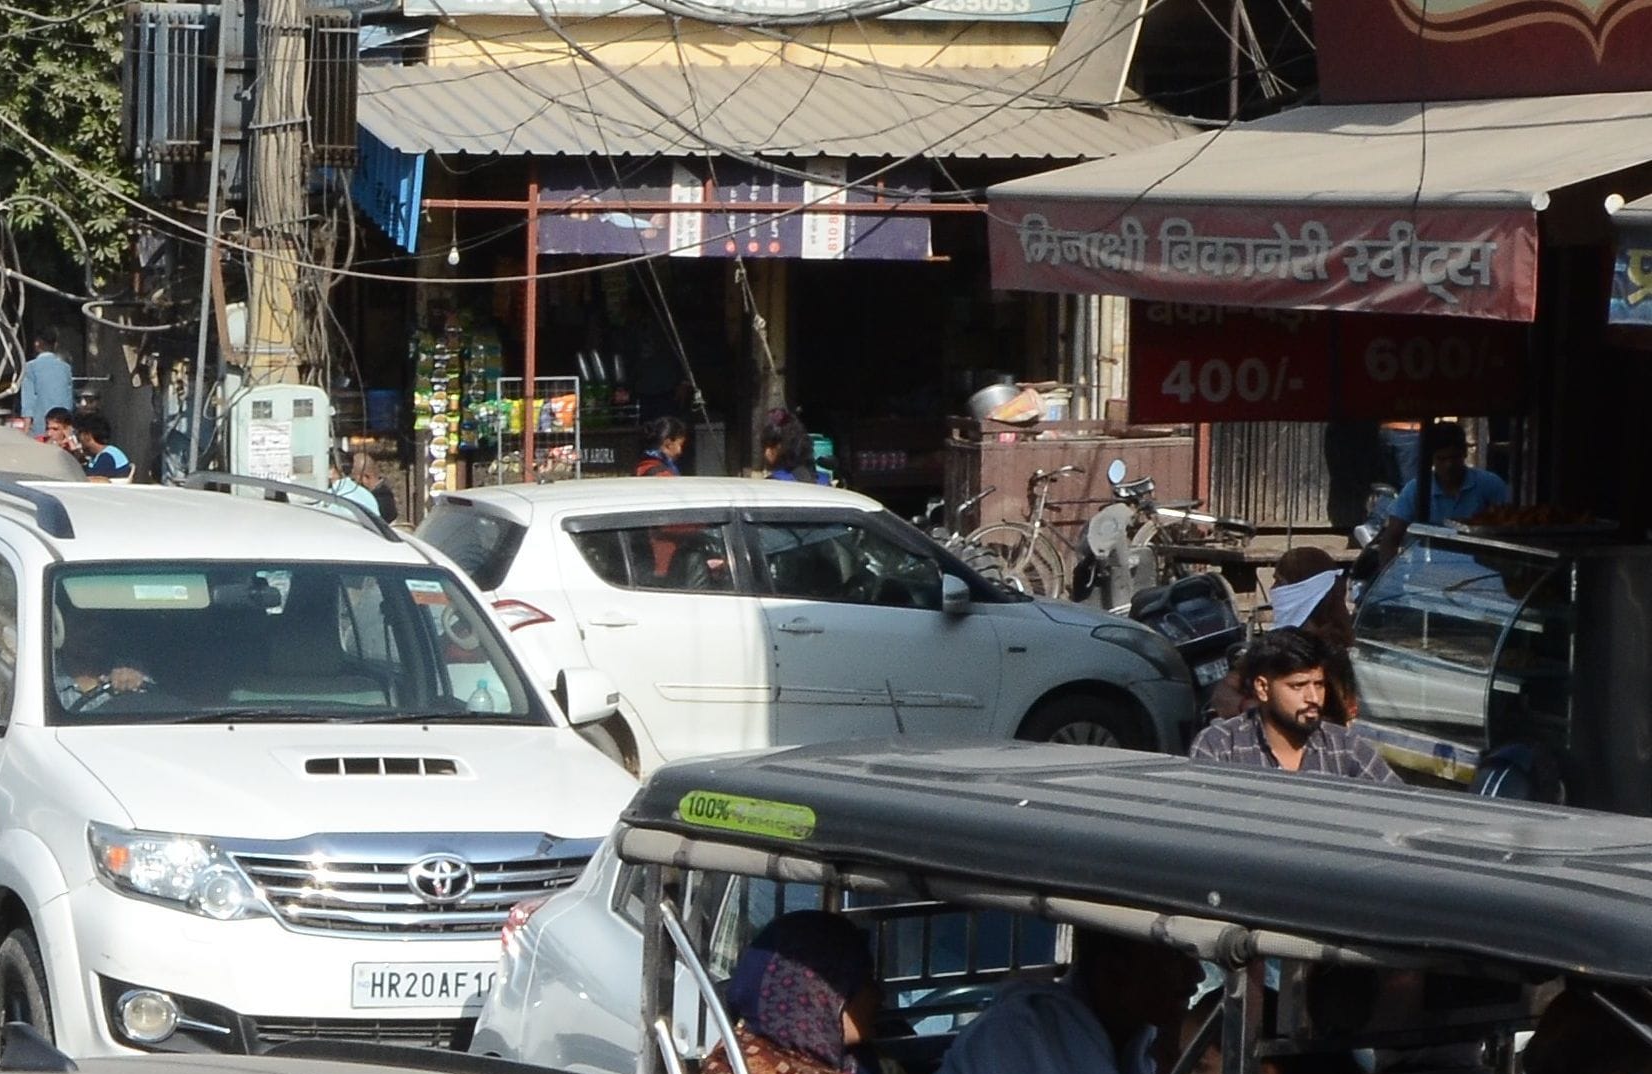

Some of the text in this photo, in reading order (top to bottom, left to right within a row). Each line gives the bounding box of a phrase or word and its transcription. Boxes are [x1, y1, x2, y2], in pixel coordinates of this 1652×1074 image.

[1157, 217, 1333, 281] बिकानेरी
[1342, 220, 1497, 304] स्वीट्स
[1161, 356, 1305, 403] 400/-
[688, 796, 731, 821] 100%
